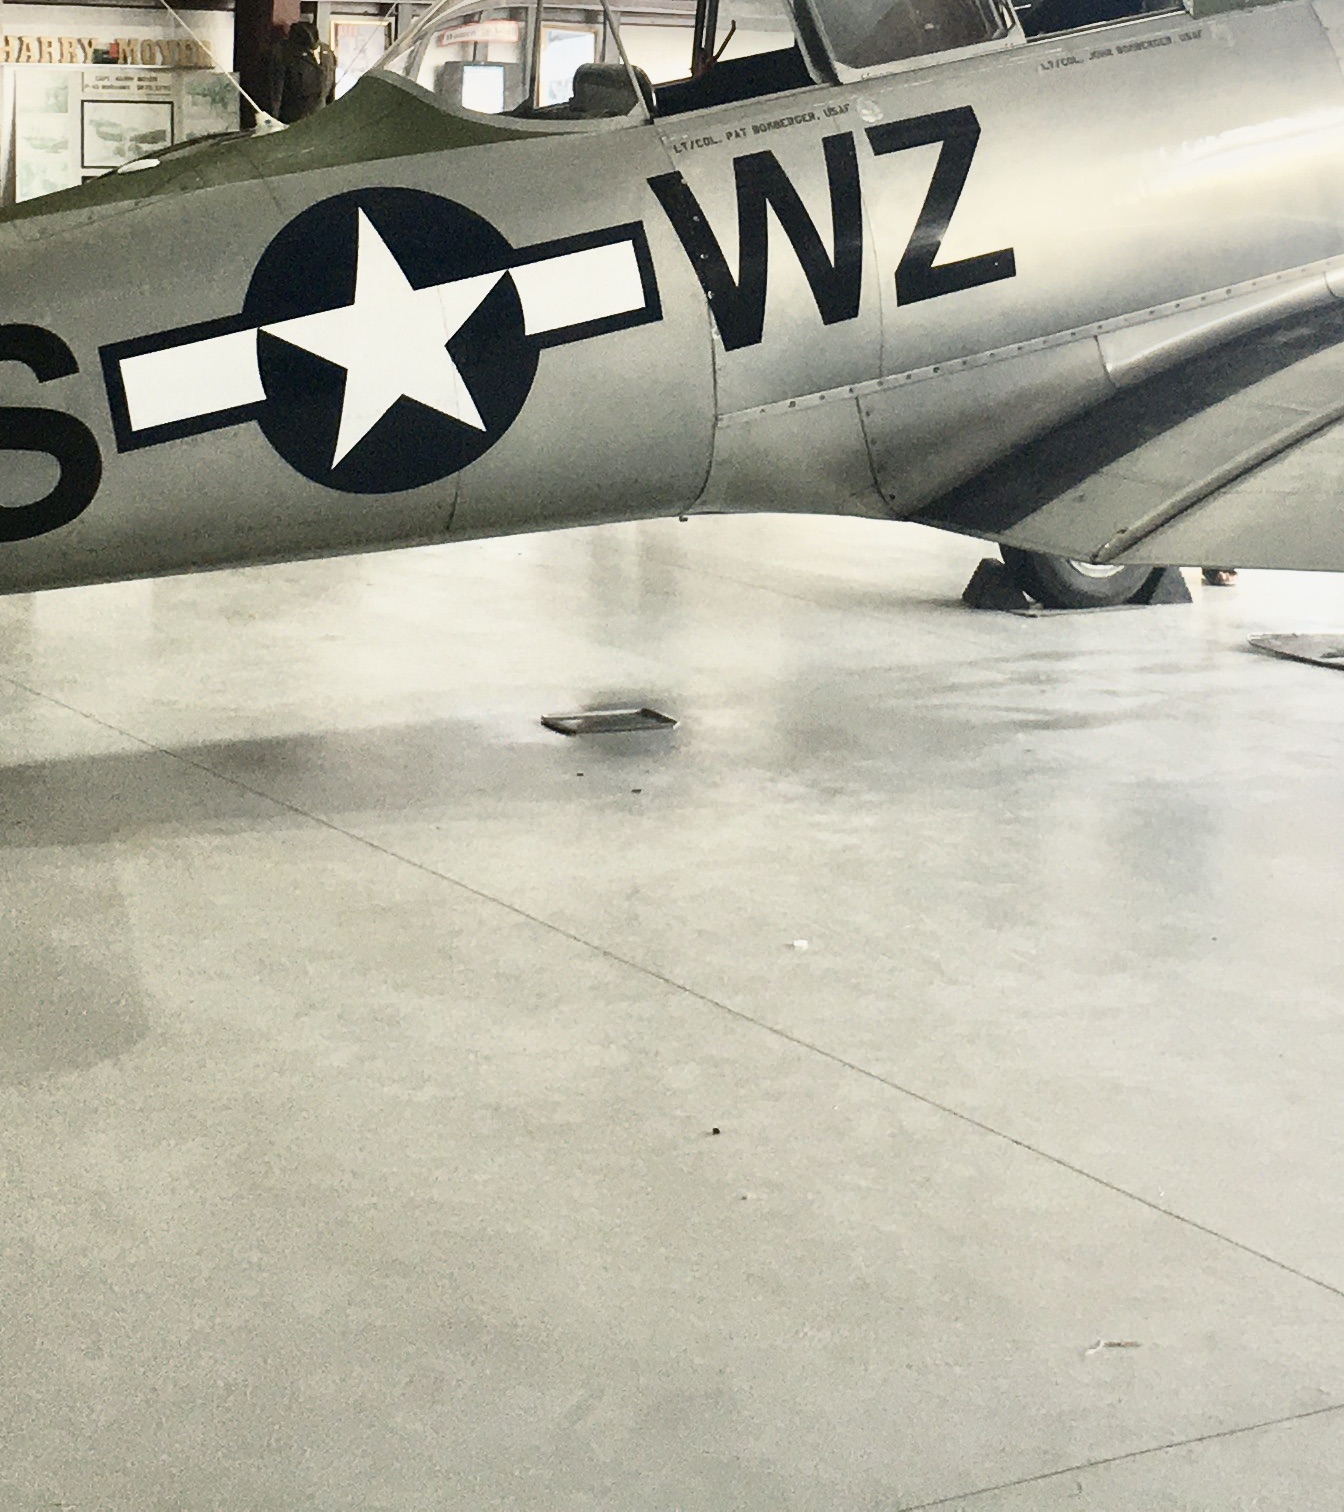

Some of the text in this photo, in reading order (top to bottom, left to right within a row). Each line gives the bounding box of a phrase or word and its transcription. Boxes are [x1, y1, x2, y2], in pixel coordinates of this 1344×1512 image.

[673, 135, 723, 154] LT/COL.
[726, 127, 747, 141] PAT
[823, 103, 850, 118] USAF
[646, 105, 1017, 352] WZ
